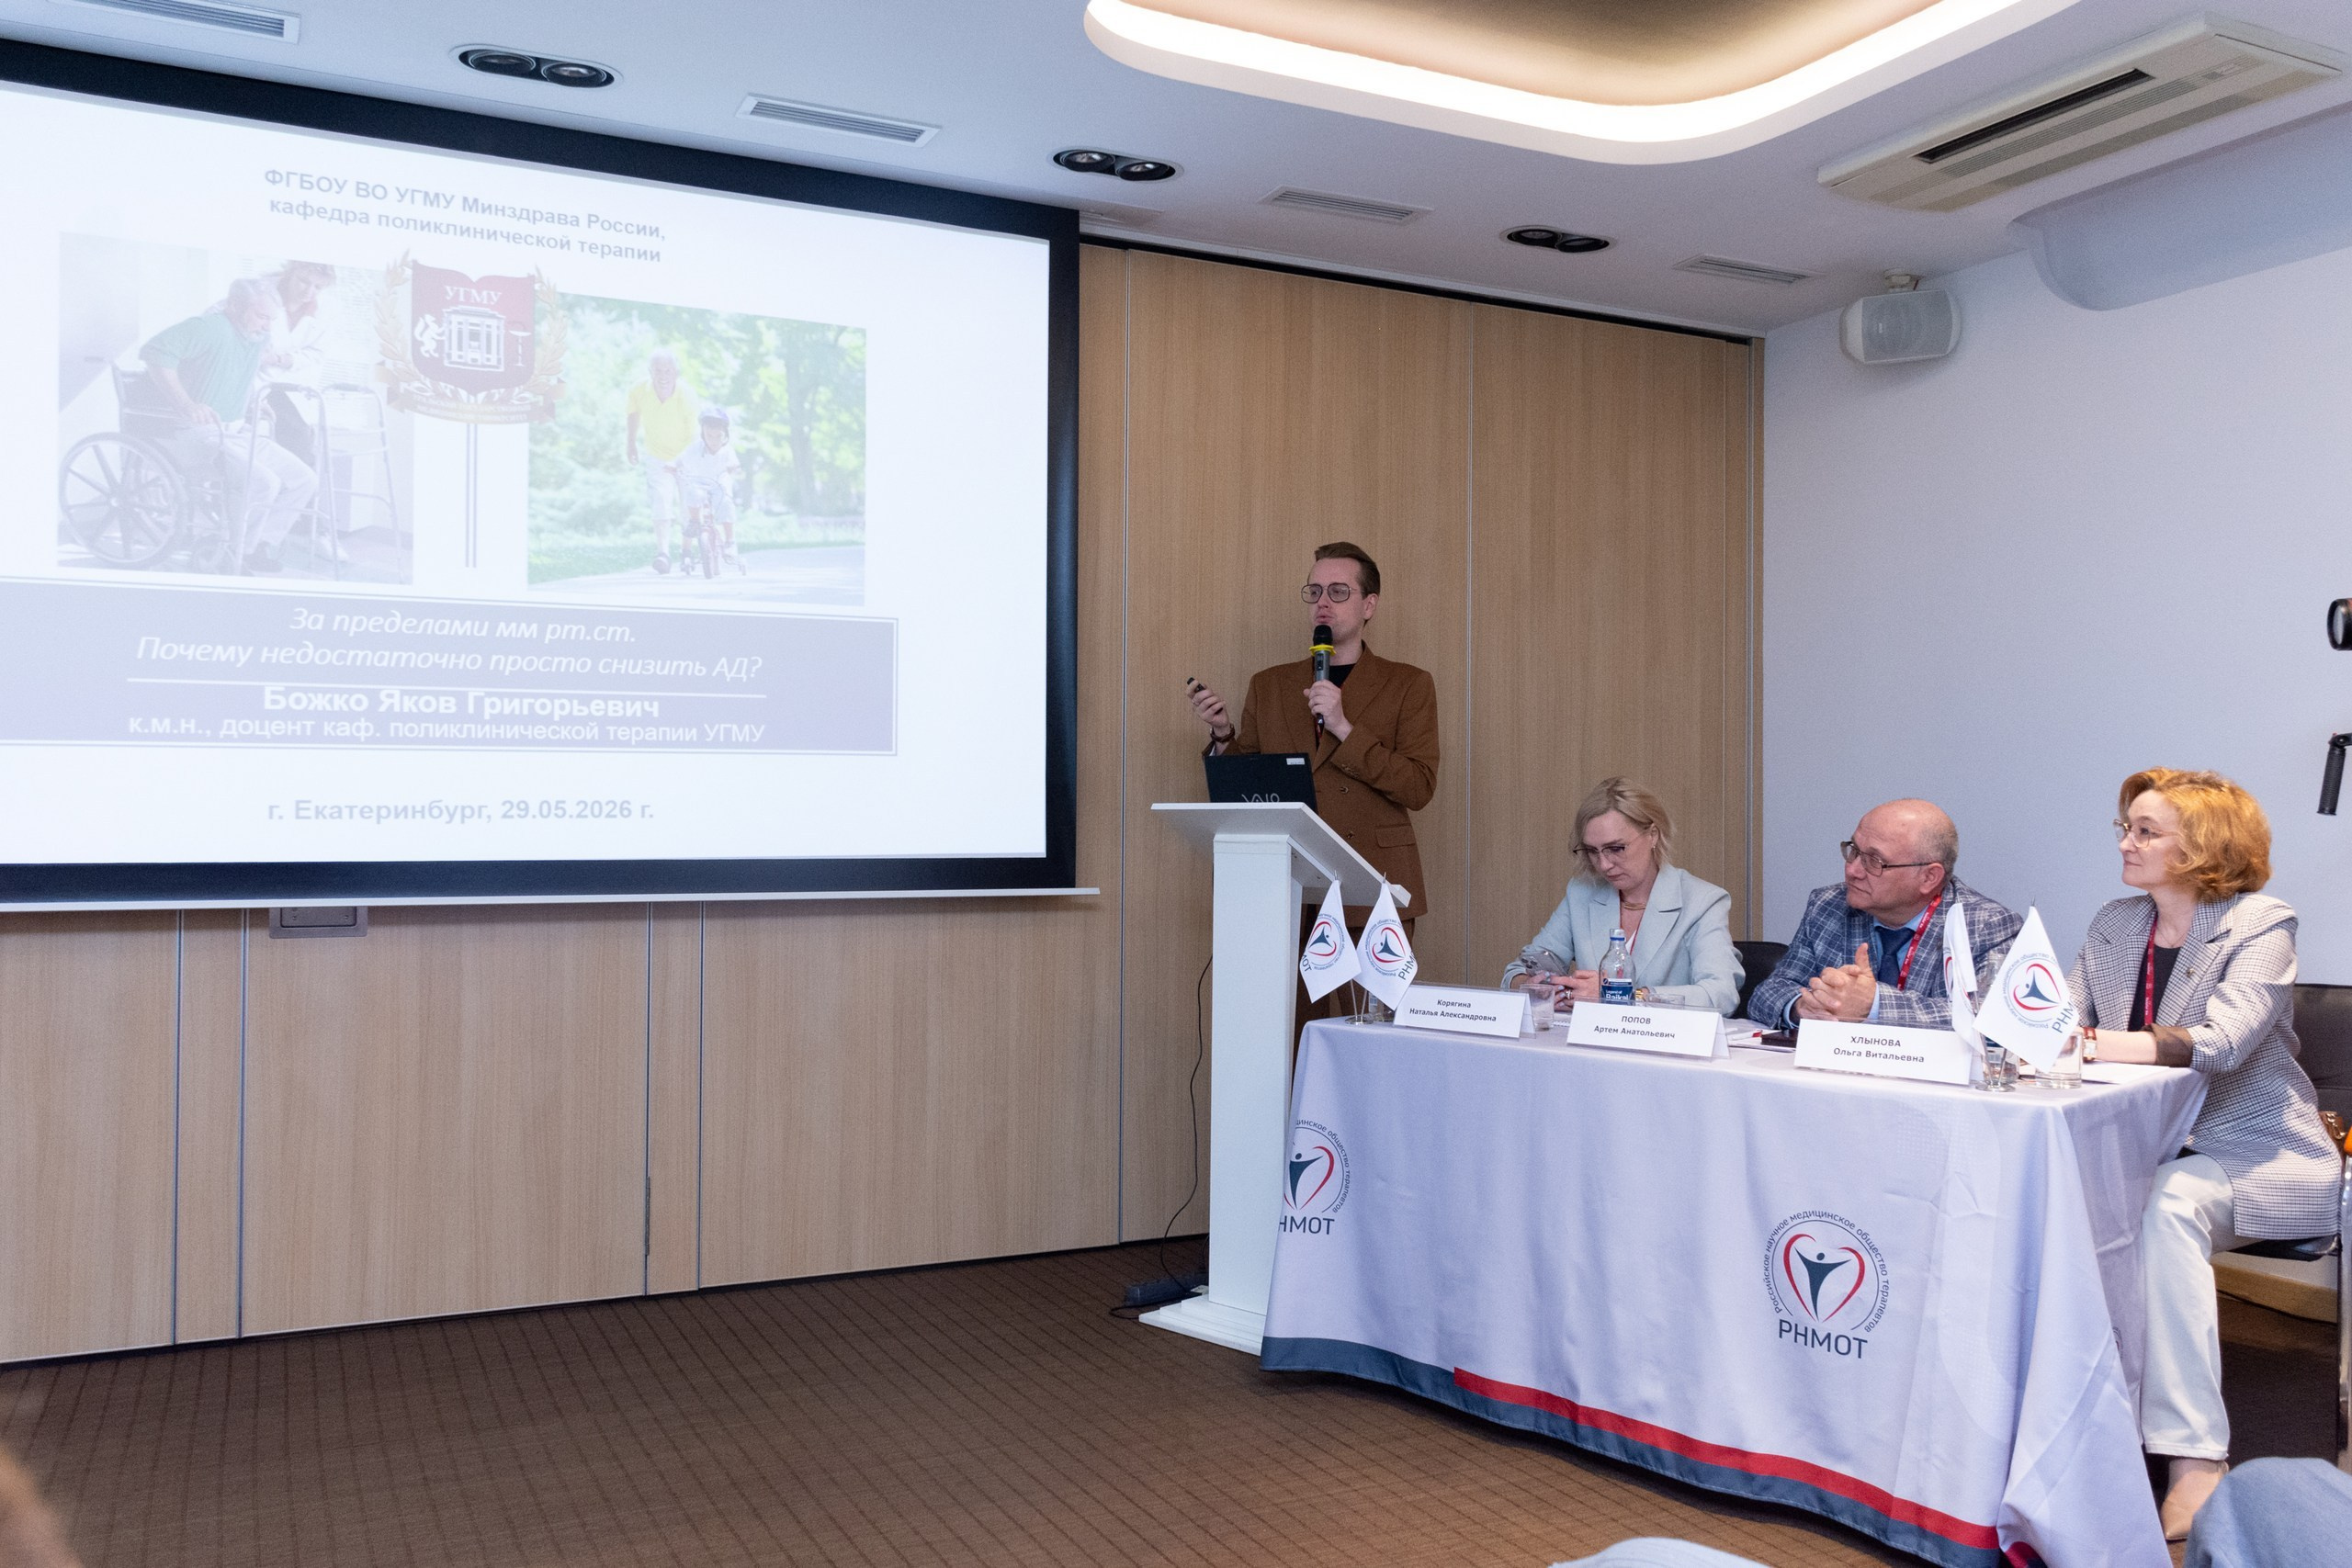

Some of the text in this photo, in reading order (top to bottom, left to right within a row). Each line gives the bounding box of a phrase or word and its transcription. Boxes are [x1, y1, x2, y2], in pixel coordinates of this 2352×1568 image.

[265, 169, 666, 241] ФГБОУ ВО УГМУ Минздрава России,
[270, 198, 661, 263] кафедра поликлинической терапии
[445, 286, 502, 305] УГМУ
[289, 607, 636, 643] За пределами мм рт.ст.
[137, 637, 763, 682] Почему недостаточно просто снизить АД?
[264, 686, 660, 721] Божко Яков Григорьевич
[129, 717, 764, 745] к.м.н., доцент каф. поликлинической терапии УГМУ
[268, 799, 654, 824] г. Екатеринбург, 29.05.2026 г.
[1409, 1008, 1497, 1022] Наталья Александровна
[1437, 998, 1472, 1010] Корягина
[1594, 1024, 1676, 1039] Артем Анатольевич
[1621, 1015, 1652, 1026] ПОПОВ
[1833, 1047, 1925, 1064] Ольга Витальевна
[1850, 1035, 1902, 1048] ХЛЫНОВА
[1327, 1130, 1351, 1168] общество
[1332, 1169, 1351, 1213] терапевтов
[1763, 1210, 1889, 1333] Российское научное медицинское общество терапевтов
[1779, 1318, 1868, 1359] РНМОТ
